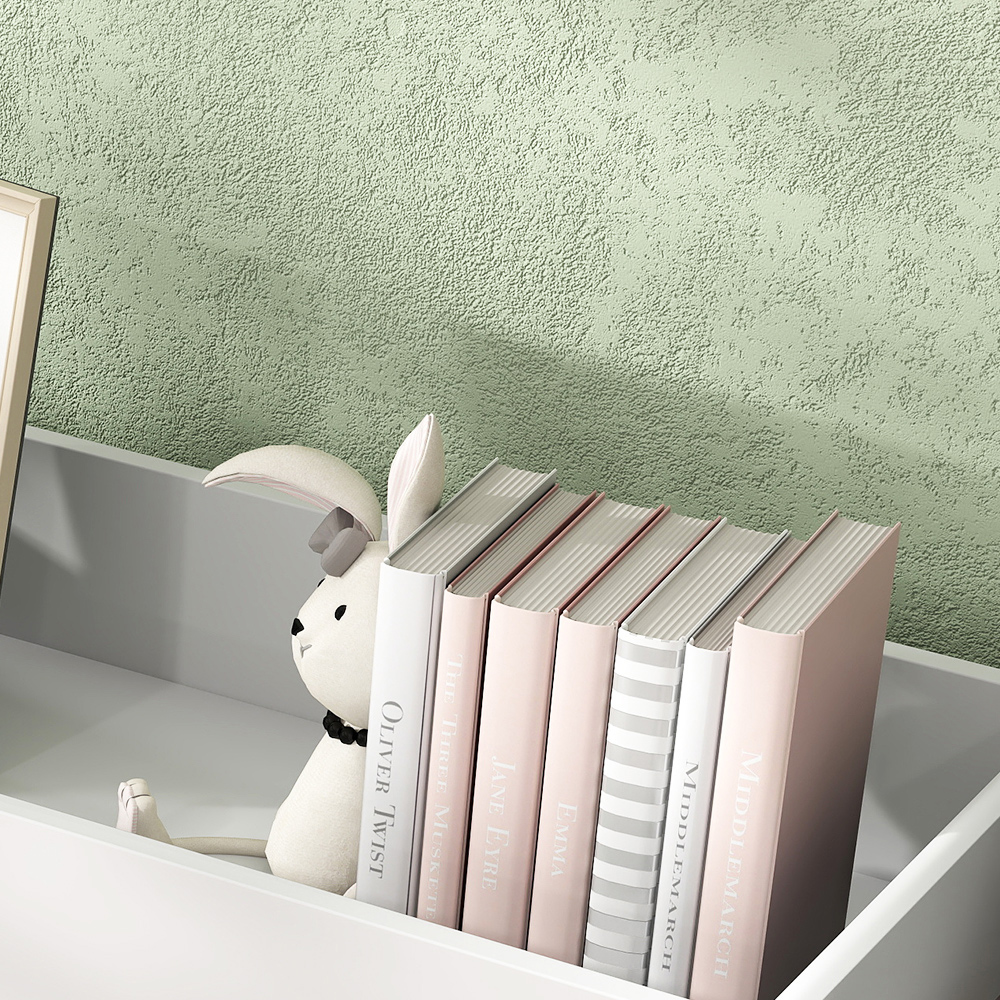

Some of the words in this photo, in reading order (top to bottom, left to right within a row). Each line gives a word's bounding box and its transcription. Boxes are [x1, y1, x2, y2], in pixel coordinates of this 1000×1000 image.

[444, 653, 464, 704] THE
[375, 700, 404, 794] OLIVER
[436, 713, 459, 793] THREE
[488, 755, 516, 816] JANE
[368, 804, 396, 880] TWIST
[482, 823, 511, 891] EYRE
[550, 801, 578, 877] EMMA
[661, 761, 700, 972] MIDDLEMARCH
[713, 748, 763, 980] MIDDLEMARCH
